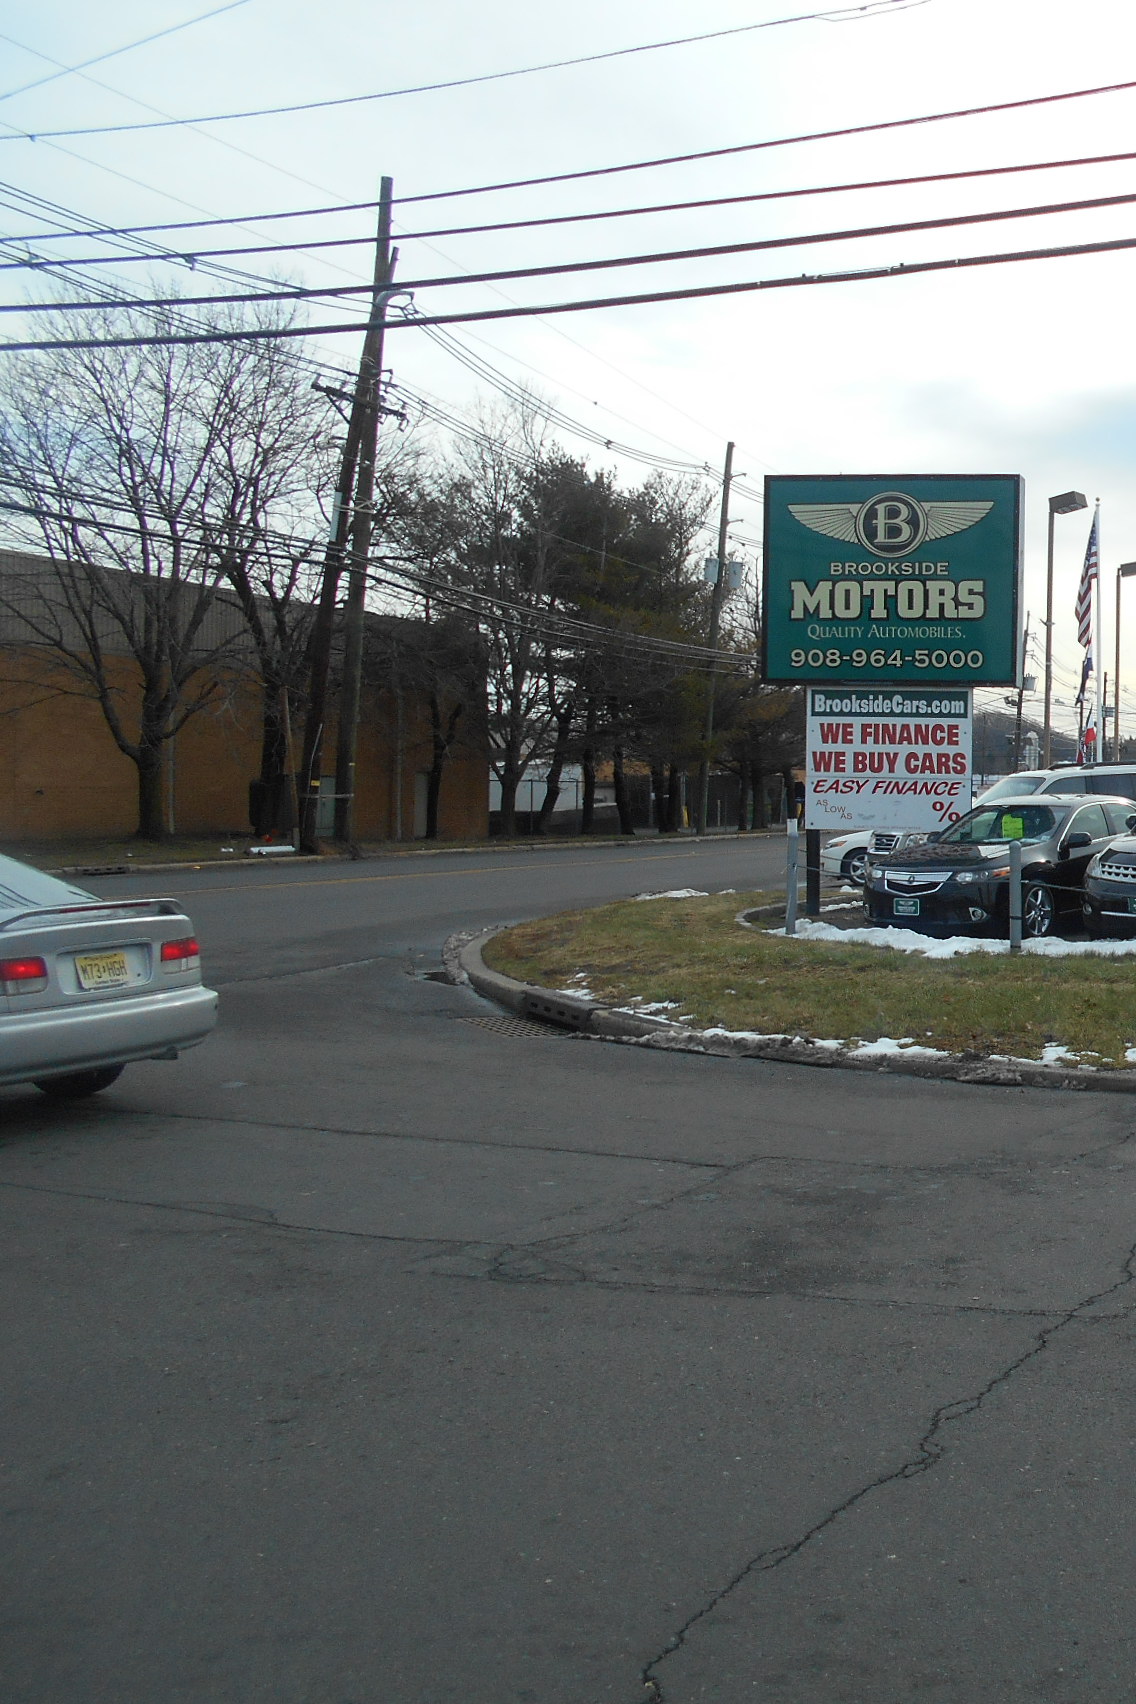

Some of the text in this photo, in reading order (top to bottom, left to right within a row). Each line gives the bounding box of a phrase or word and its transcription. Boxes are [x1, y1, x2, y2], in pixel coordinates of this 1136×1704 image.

[830, 562, 949, 575] BROOKSIDE
[790, 580, 986, 620] MOTORS
[790, 649, 984, 668] 908-964-5000
[814, 694, 965, 714] BrooksideCars.com
[819, 723, 960, 746] WE FINANCE
[812, 751, 967, 775] WE BUY CARS
[813, 779, 962, 796] EASY FINANCE
